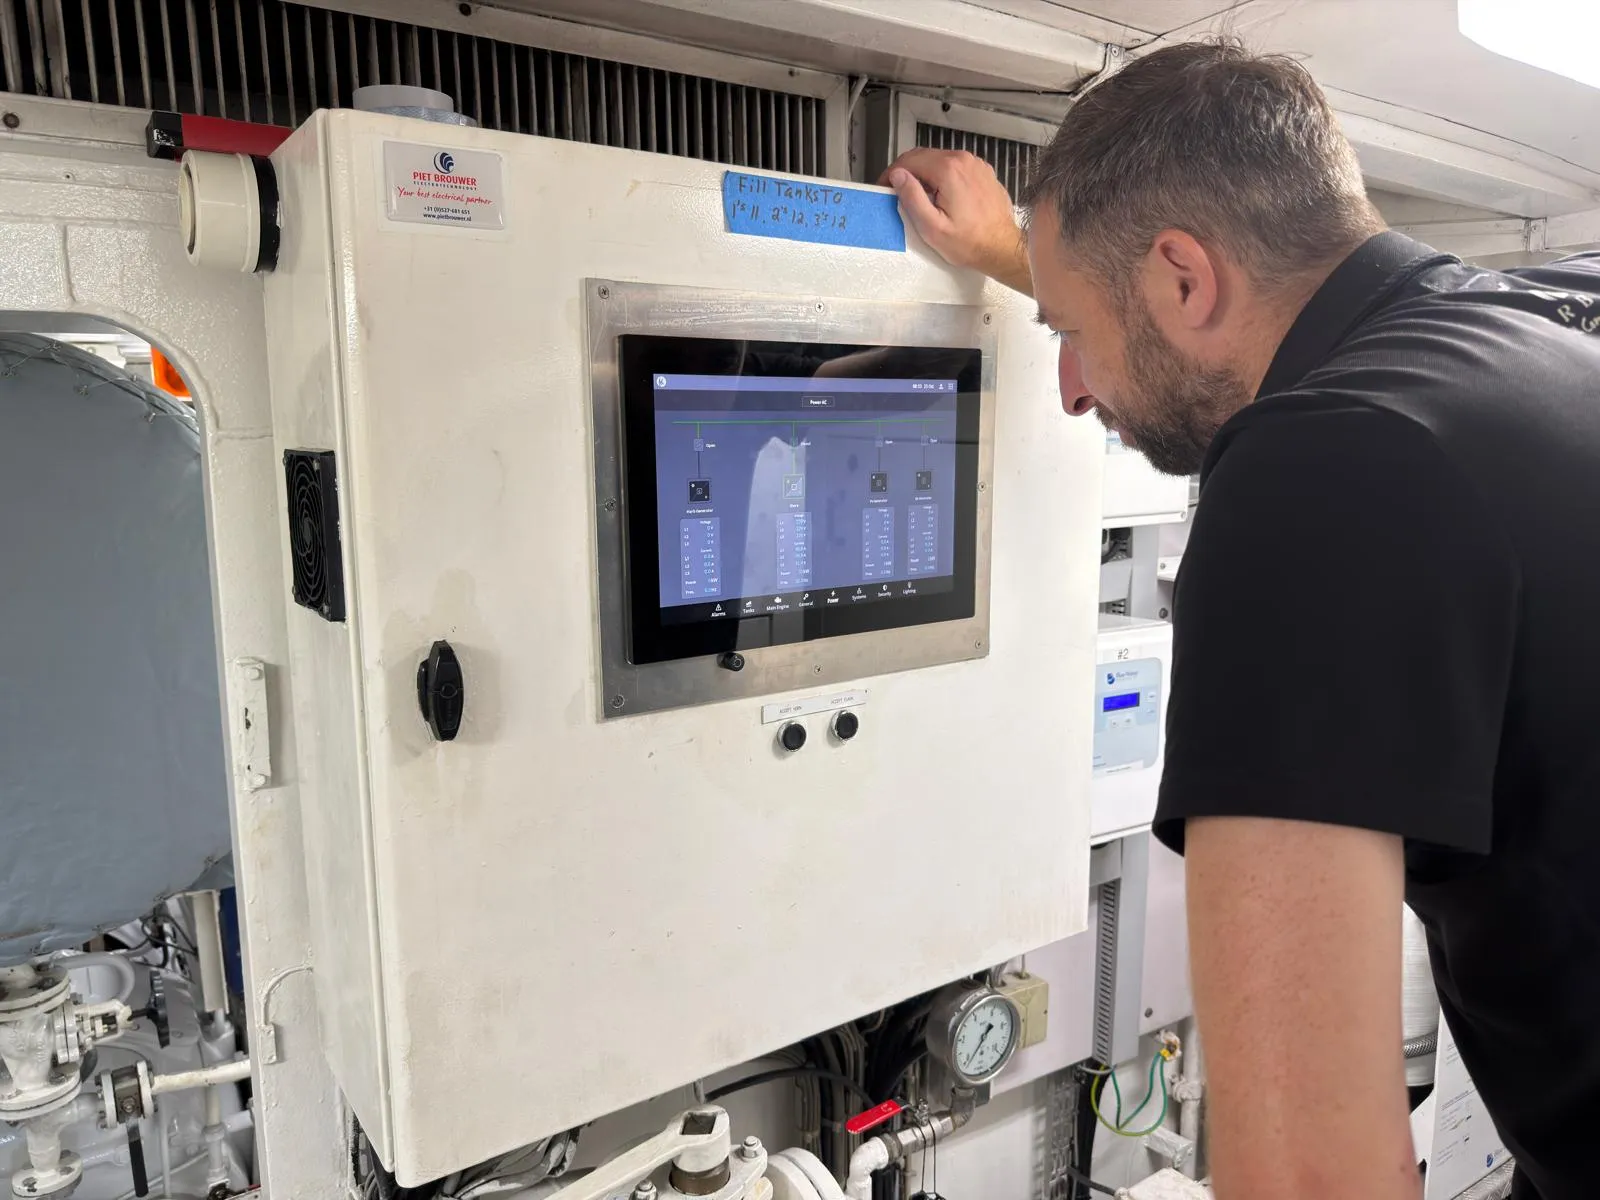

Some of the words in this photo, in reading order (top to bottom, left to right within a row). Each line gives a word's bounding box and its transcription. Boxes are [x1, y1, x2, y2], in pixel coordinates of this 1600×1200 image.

[413, 171, 431, 181] PIET
[434, 173, 477, 186] BROUWER
[739, 176, 766, 193] Fill
[397, 186, 414, 197] Your
[417, 187, 430, 198] best
[432, 190, 464, 201] electrical
[466, 195, 493, 206] partner
[1117, 648, 1128, 660] #2
